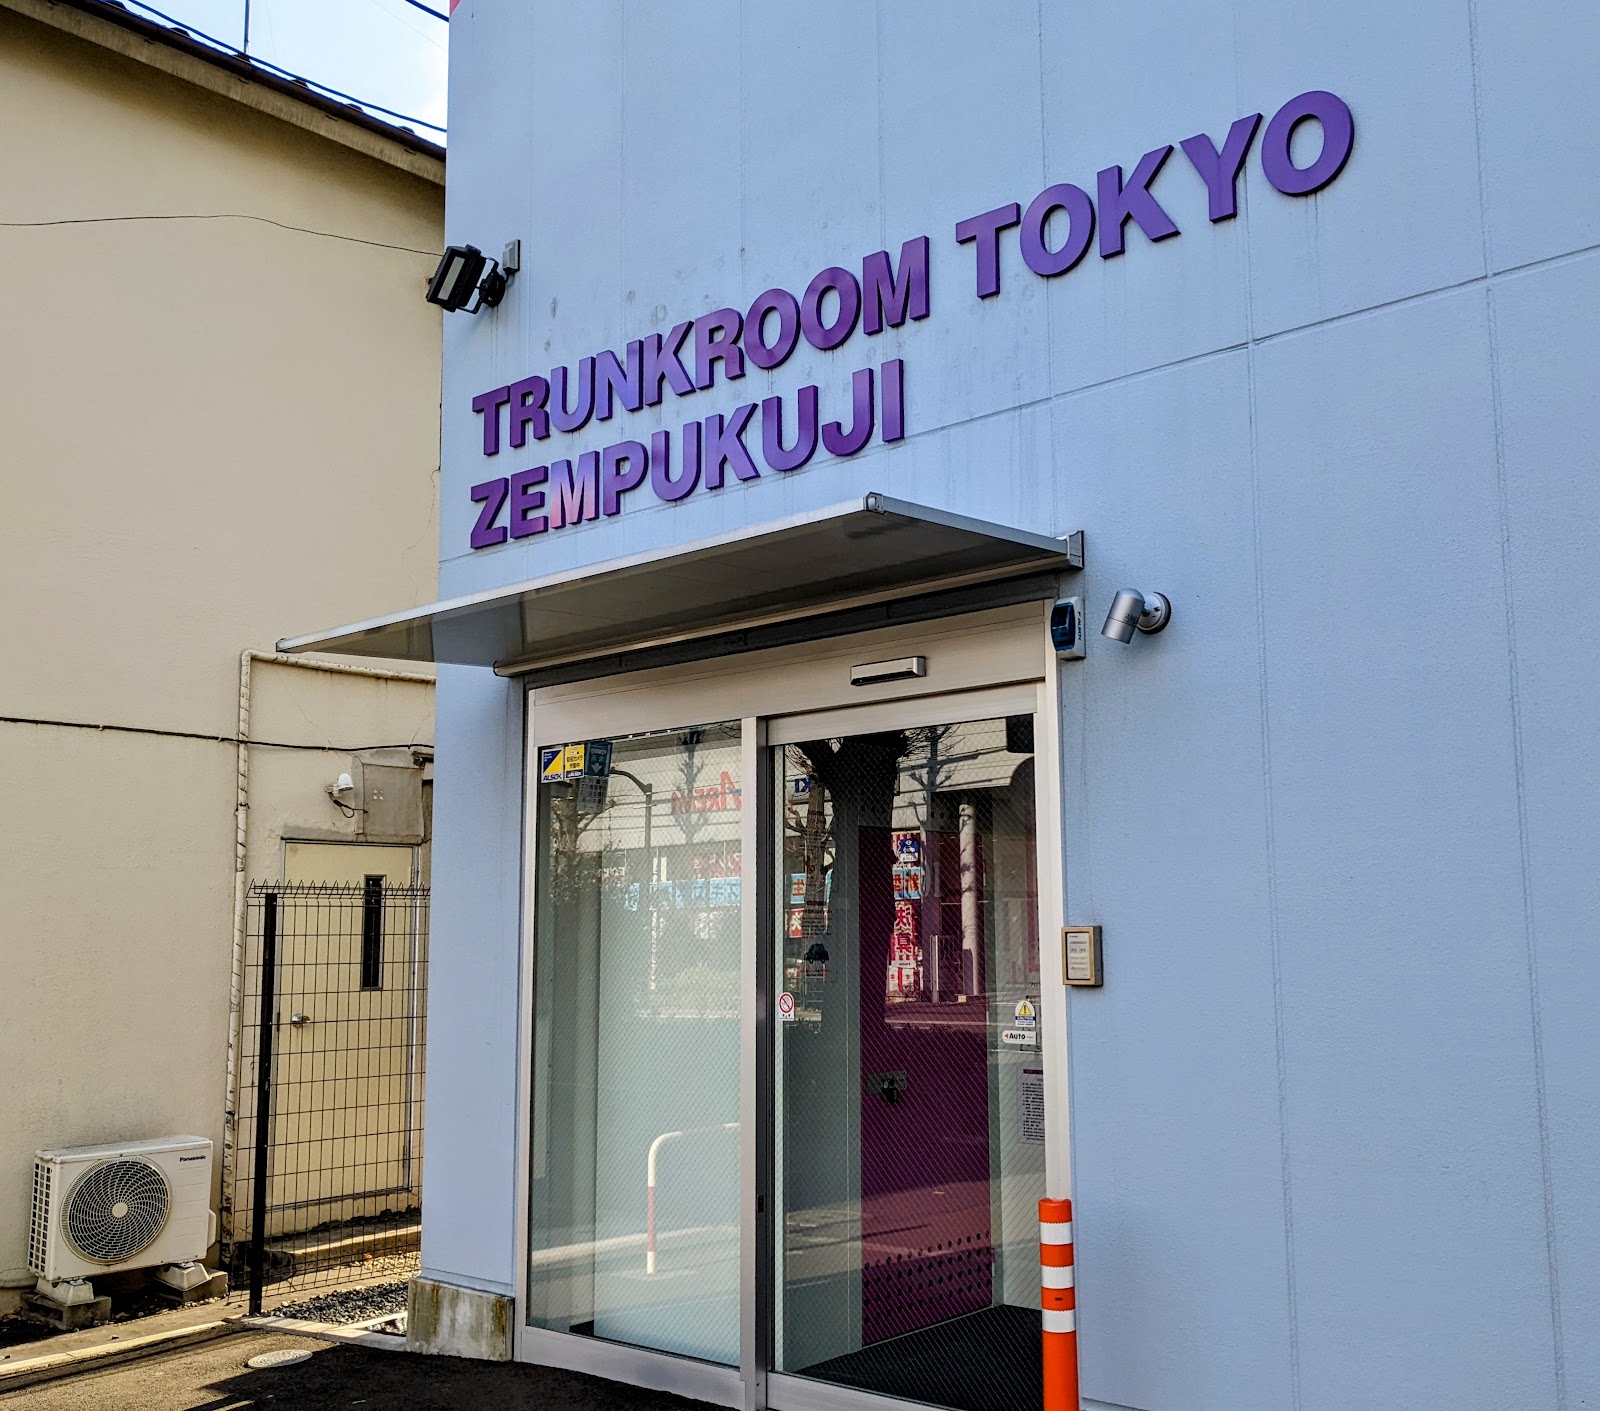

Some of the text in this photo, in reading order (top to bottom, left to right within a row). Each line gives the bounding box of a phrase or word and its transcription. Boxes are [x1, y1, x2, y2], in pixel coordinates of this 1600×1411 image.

[471, 90, 1355, 456] TRUNKROOM TOKYO
[470, 358, 905, 550] ZEMPUKUJI
[543, 773, 562, 781] ALSOK
